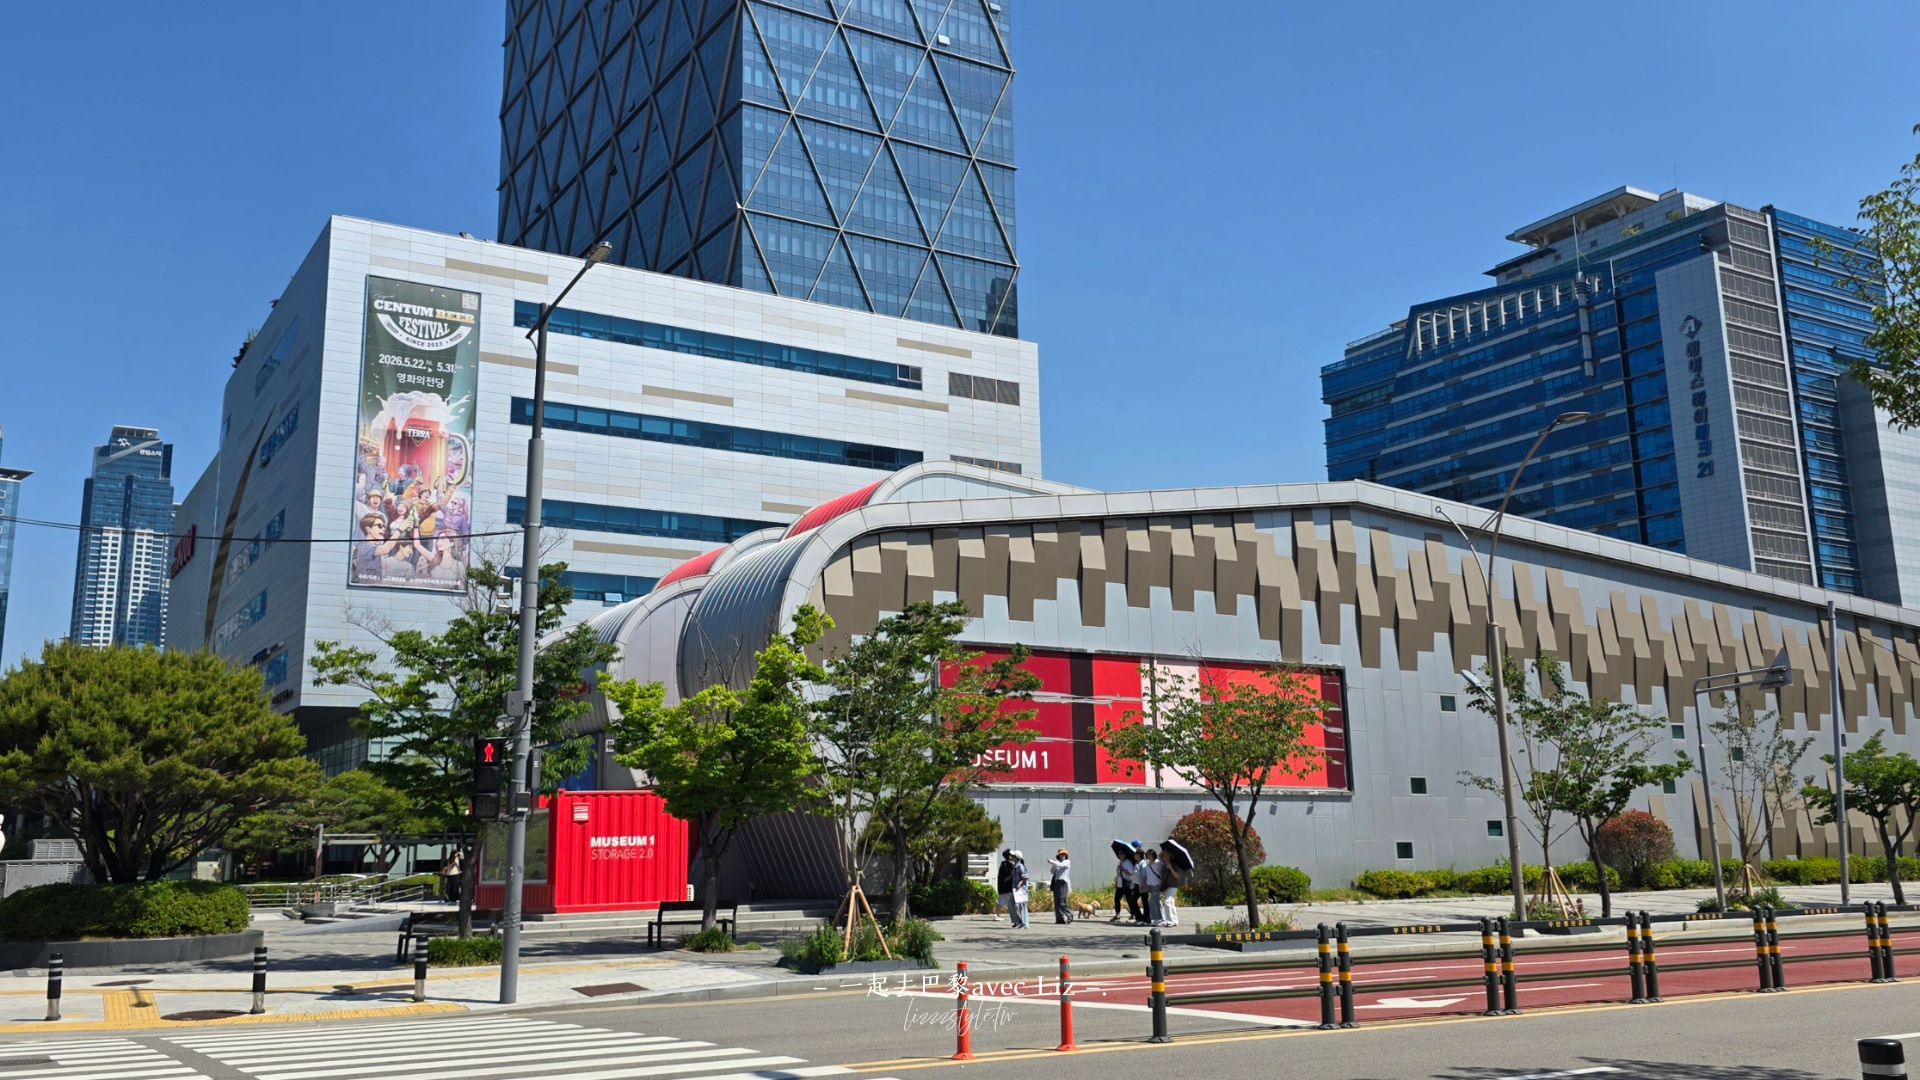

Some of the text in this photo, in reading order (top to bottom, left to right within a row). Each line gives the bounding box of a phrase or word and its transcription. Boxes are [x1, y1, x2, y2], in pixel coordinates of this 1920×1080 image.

[373, 300, 475, 324] CENTUM BEER
[399, 316, 450, 339] FESTIVAL
[406, 336, 424, 346] SINCE
[378, 354, 426, 369] 2026.5.22.
[397, 373, 444, 388] 영화의전당
[407, 428, 431, 439] TERRA
[1041, 751, 1048, 768] 1
[590, 835, 655, 847] MUSEUM 1
[592, 848, 654, 860] STORAGE 2.0
